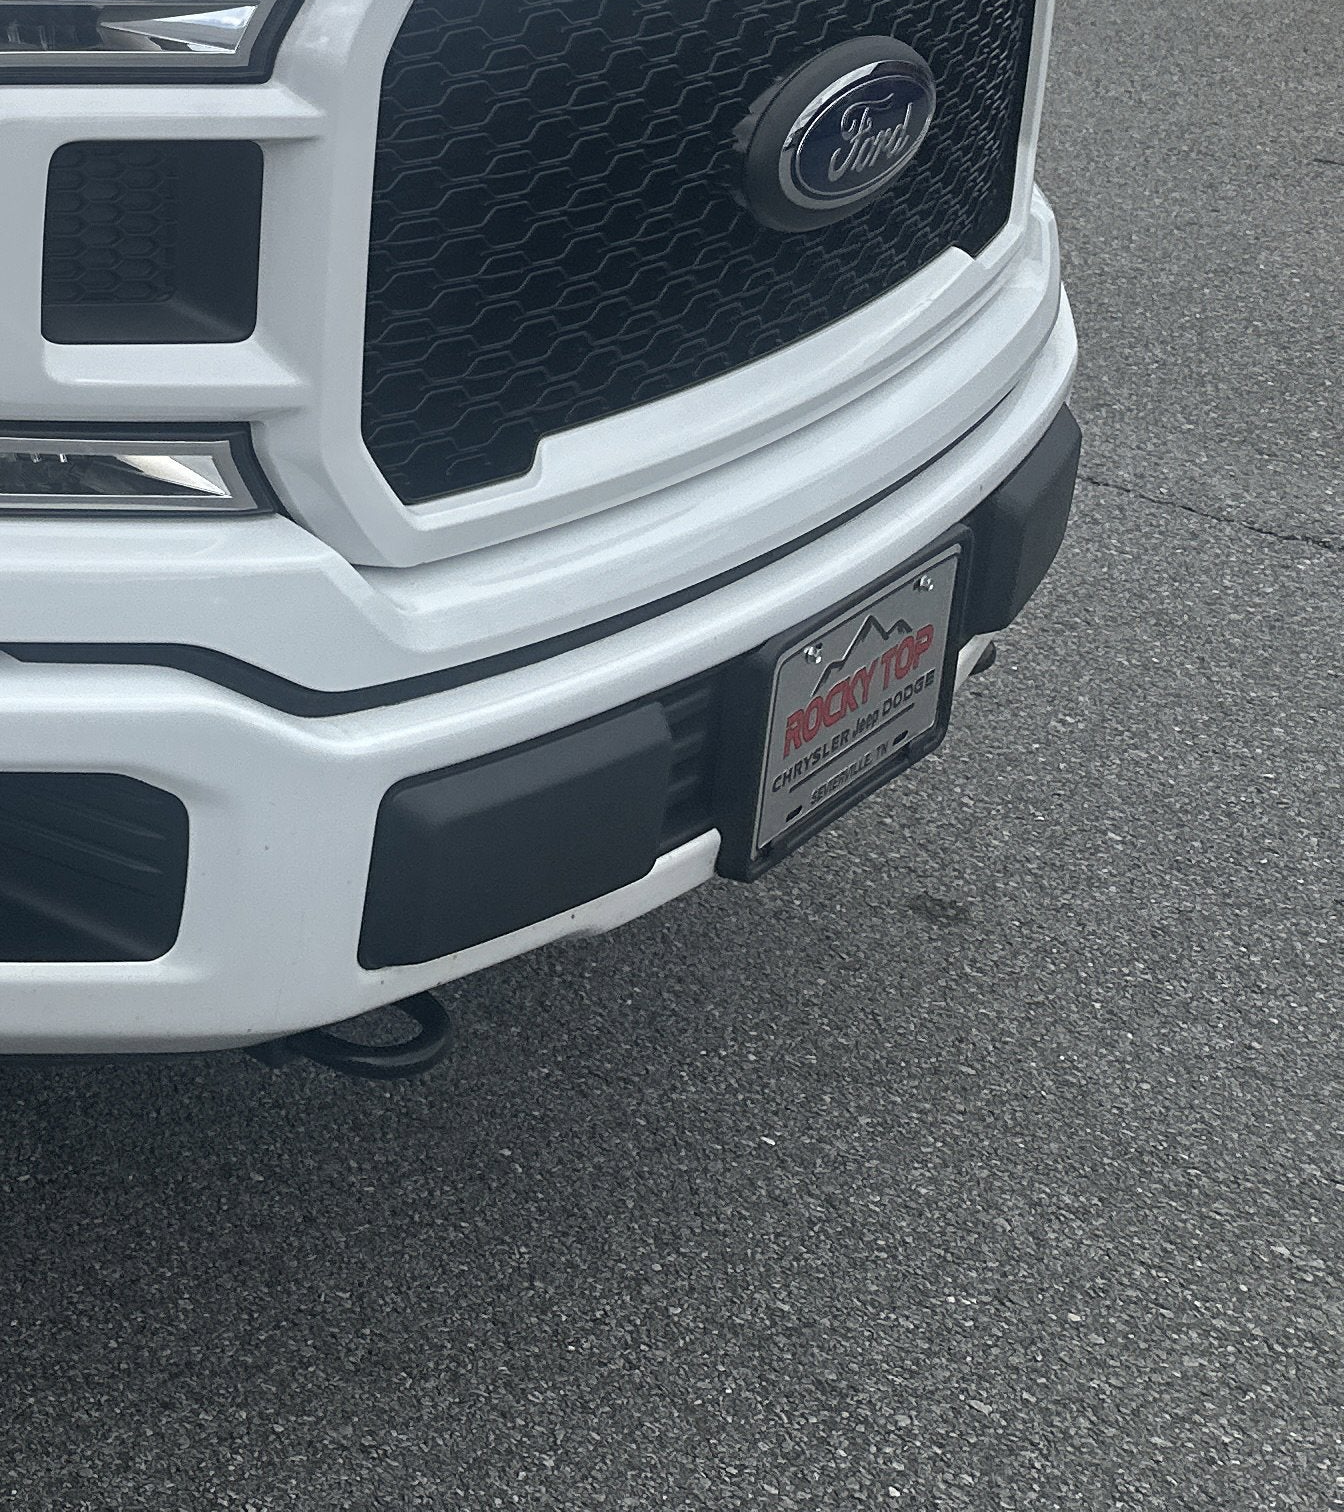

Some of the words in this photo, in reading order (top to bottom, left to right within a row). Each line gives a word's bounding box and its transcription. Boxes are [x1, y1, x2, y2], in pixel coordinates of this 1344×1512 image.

[828, 92, 914, 183] Ford
[772, 728, 851, 793] CHRYSLER
[852, 710, 880, 739] Jeep
[882, 668, 936, 716] DODGE
[783, 657, 879, 759] ROCKY
[880, 624, 935, 690] TOP
